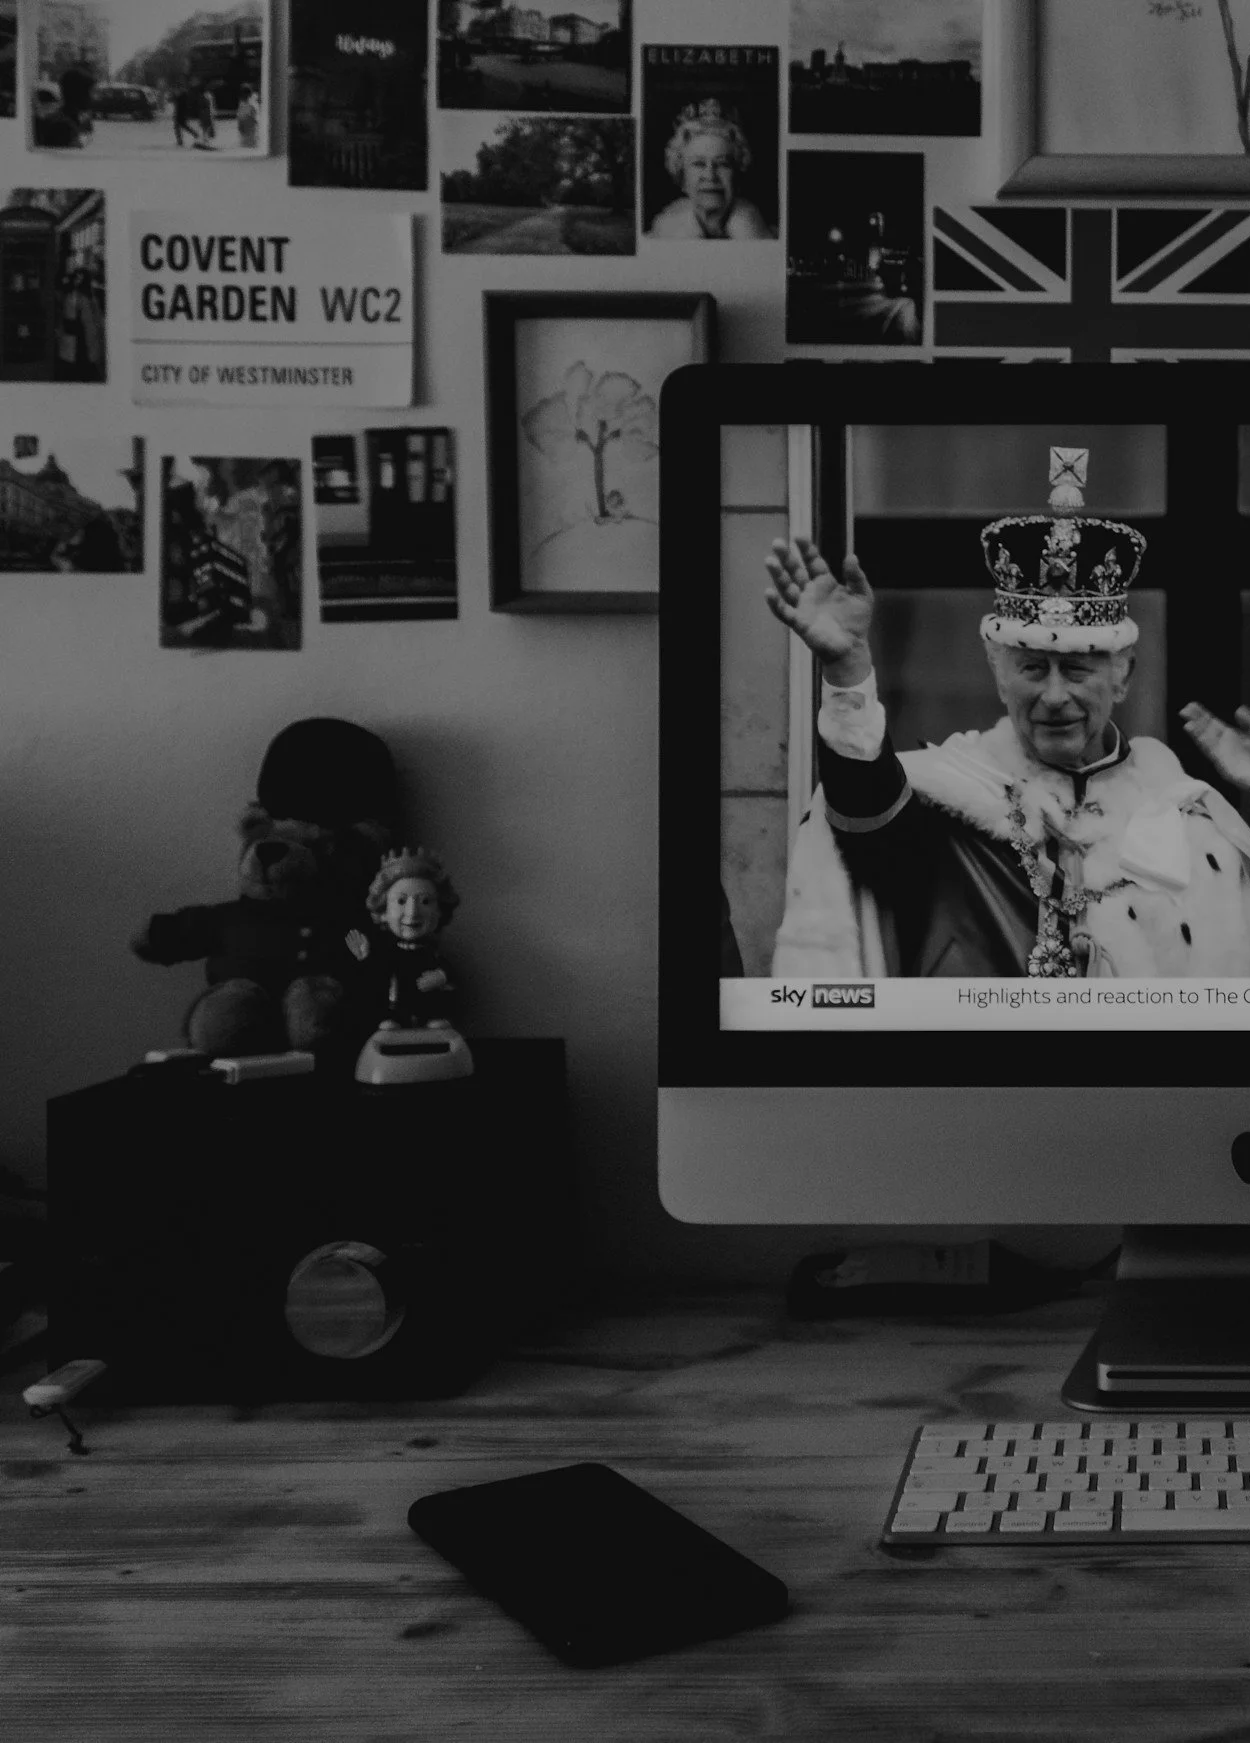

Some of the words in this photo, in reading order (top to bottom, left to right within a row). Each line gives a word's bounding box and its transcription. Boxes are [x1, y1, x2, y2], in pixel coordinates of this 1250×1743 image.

[648, 49, 772, 65] ELIZABETH
[141, 234, 290, 273] COVENT
[142, 283, 296, 323] GARDEN
[321, 287, 401, 323] WC2
[141, 364, 183, 384] CITY
[188, 366, 210, 385] OF
[217, 366, 353, 386] WESTMINSTER
[771, 986, 807, 1007] sky
[814, 987, 873, 1005] news
[959, 988, 1051, 1008] Highlights
[1057, 988, 1091, 1004] and
[1098, 988, 1173, 1004] reaction
[1179, 990, 1198, 1004] to
[1204, 988, 1238, 1004] The
